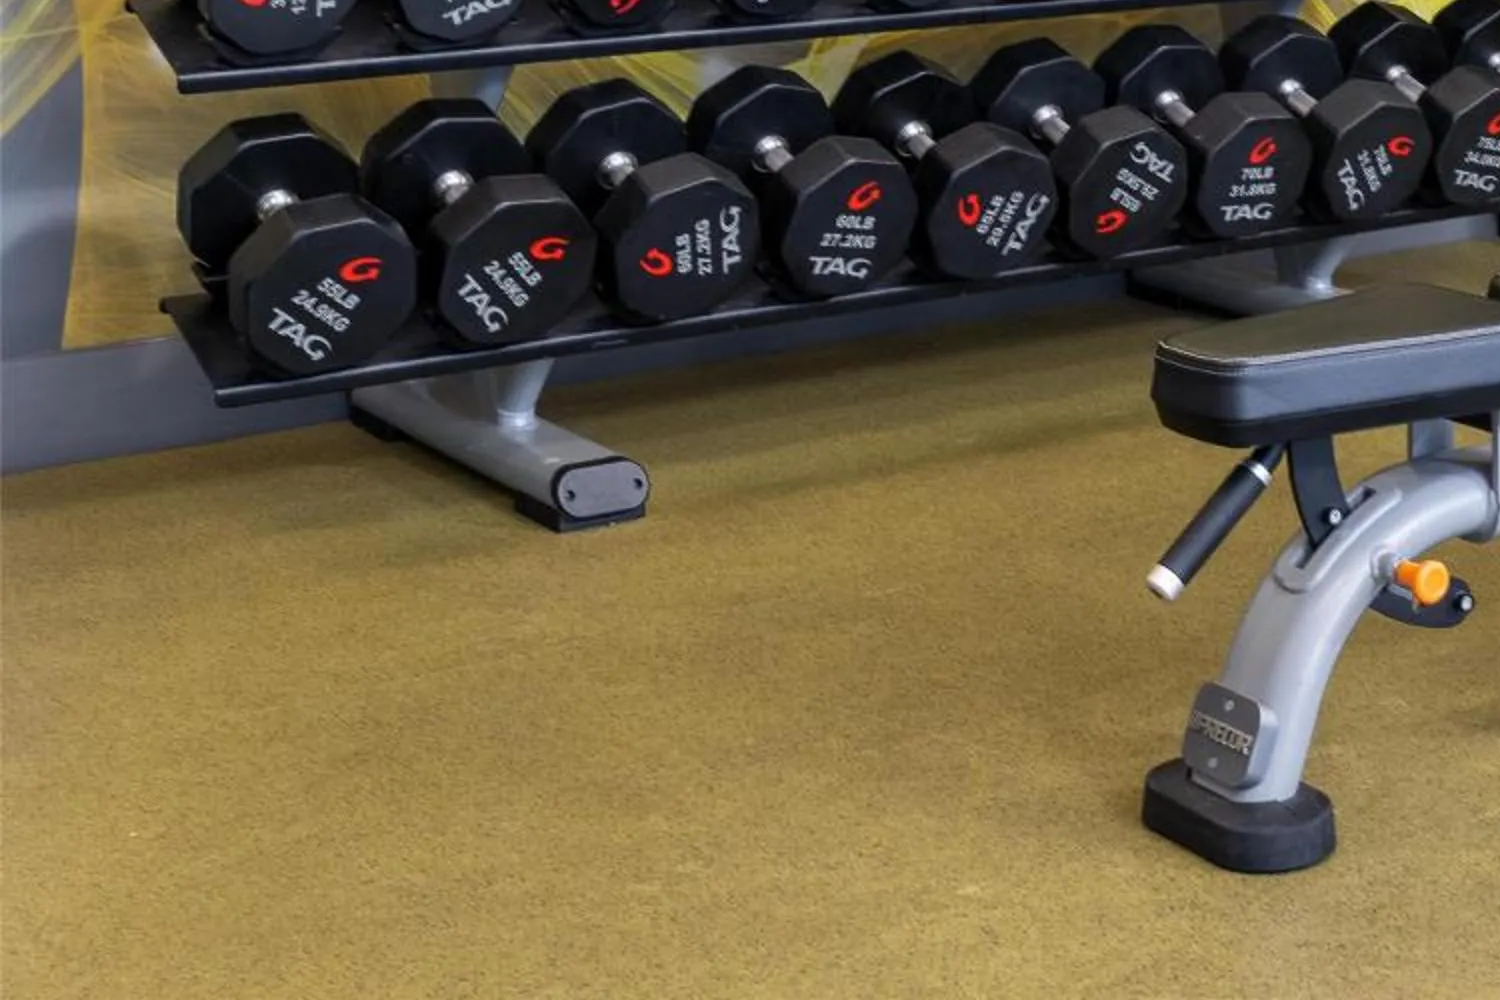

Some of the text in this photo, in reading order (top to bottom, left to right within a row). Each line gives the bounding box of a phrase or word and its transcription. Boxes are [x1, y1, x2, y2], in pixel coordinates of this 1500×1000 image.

[1130, 142, 1175, 184] TAG
[1454, 169, 1498, 193] TAG
[1338, 158, 1365, 212] TAG
[835, 215, 876, 230] 60LB
[1002, 193, 1050, 256] TAG
[1220, 203, 1275, 223] TAG
[696, 219, 712, 276] 27.2KG
[719, 205, 742, 274] TAG
[820, 233, 877, 250] 27.2KG
[483, 260, 529, 307] 24.9KG
[508, 252, 543, 287] 55LB
[808, 257, 872, 280] TAG
[292, 289, 351, 332] 24.9KG
[317, 277, 361, 310] 55LB
[459, 274, 509, 332] TAG
[268, 307, 333, 361] TAG
